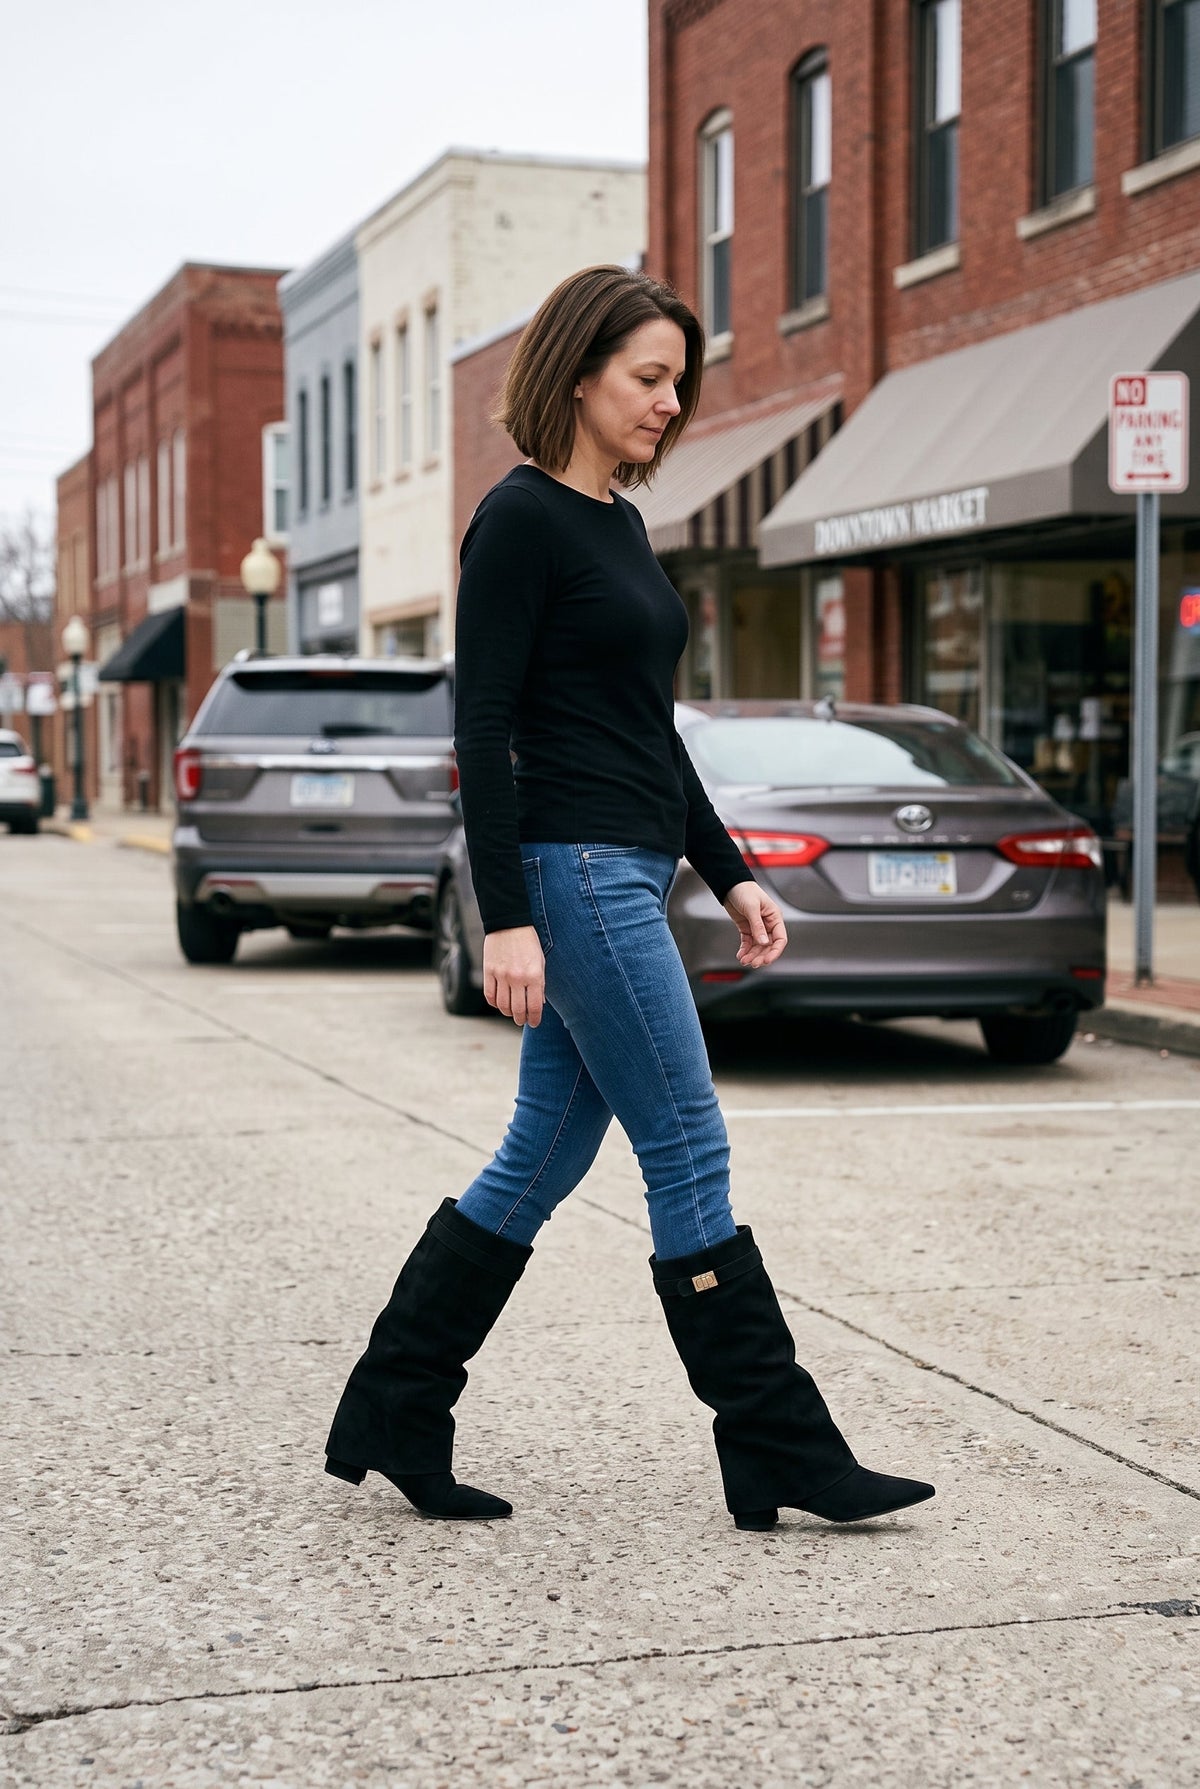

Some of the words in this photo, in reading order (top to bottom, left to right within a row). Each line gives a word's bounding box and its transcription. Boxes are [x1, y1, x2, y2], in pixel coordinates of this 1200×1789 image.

[1116, 379, 1144, 404] NO
[1118, 410, 1182, 429] PARKING
[1135, 434, 1163, 447] ANY
[1133, 451, 1165, 466] TIME
[814, 504, 910, 555] DOWNTOWN
[912, 486, 989, 535] MARKET
